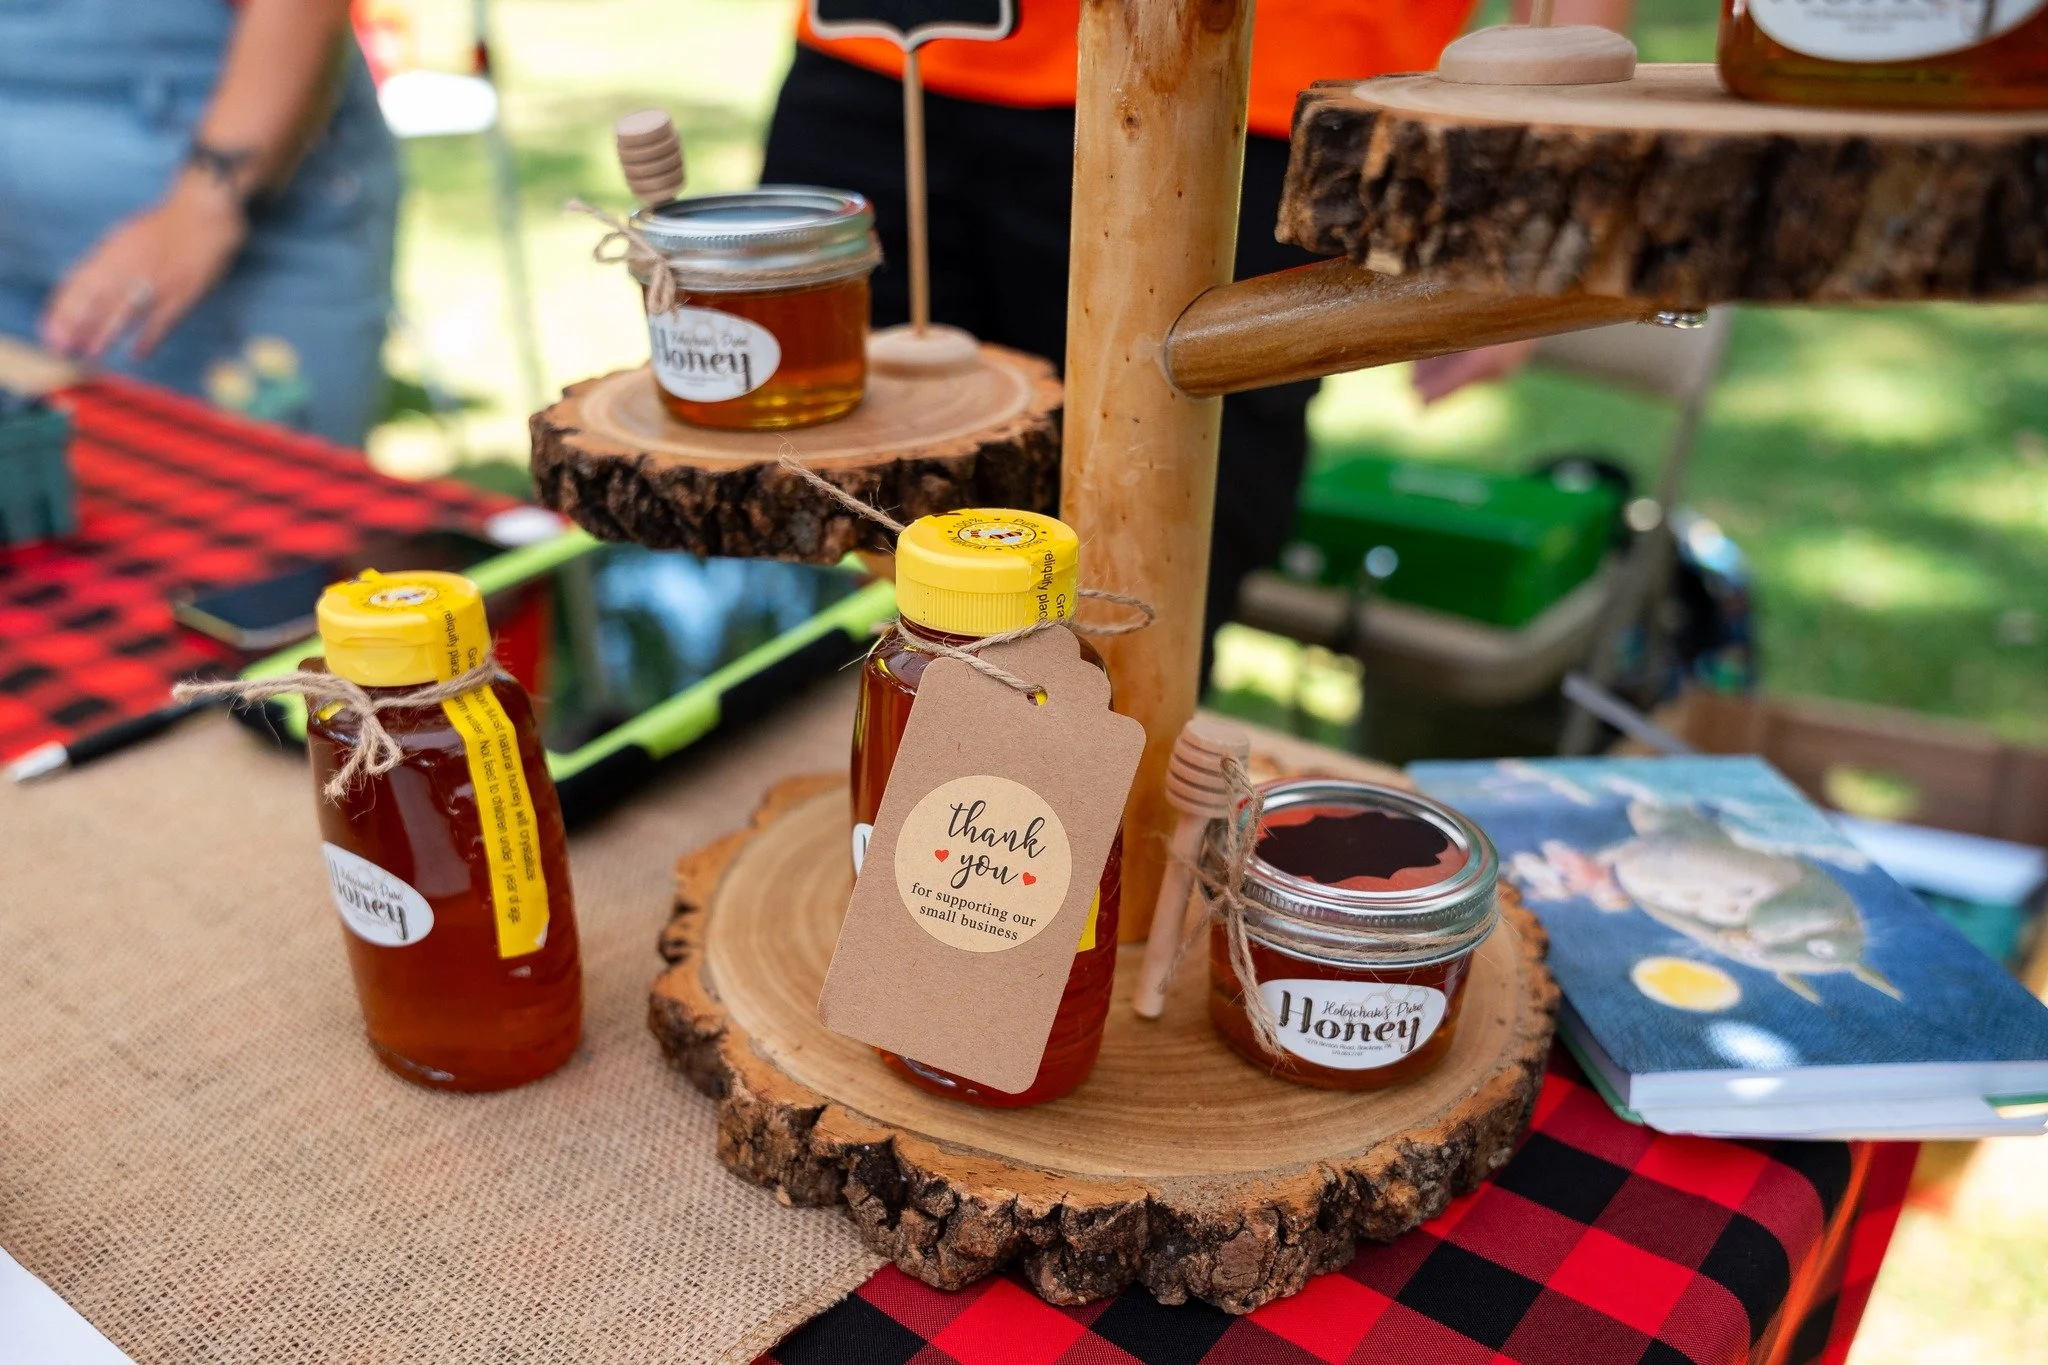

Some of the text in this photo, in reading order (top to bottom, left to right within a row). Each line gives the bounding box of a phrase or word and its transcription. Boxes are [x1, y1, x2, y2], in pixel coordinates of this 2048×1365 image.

[480, 739, 492, 758] Not
[484, 759, 497, 781] feed
[498, 733, 514, 772] natural
[507, 774, 523, 807] honey
[515, 810, 530, 826] will
[488, 783, 500, 794] to
[492, 795, 508, 833] children
[948, 799, 1046, 859] thank
[499, 834, 513, 862] under
[950, 854, 1019, 889] you
[910, 882, 1037, 928] for supporting our
[919, 904, 1018, 941] small business
[1278, 989, 1420, 1053] Honey
[1395, 1001, 1424, 1017] Pure
